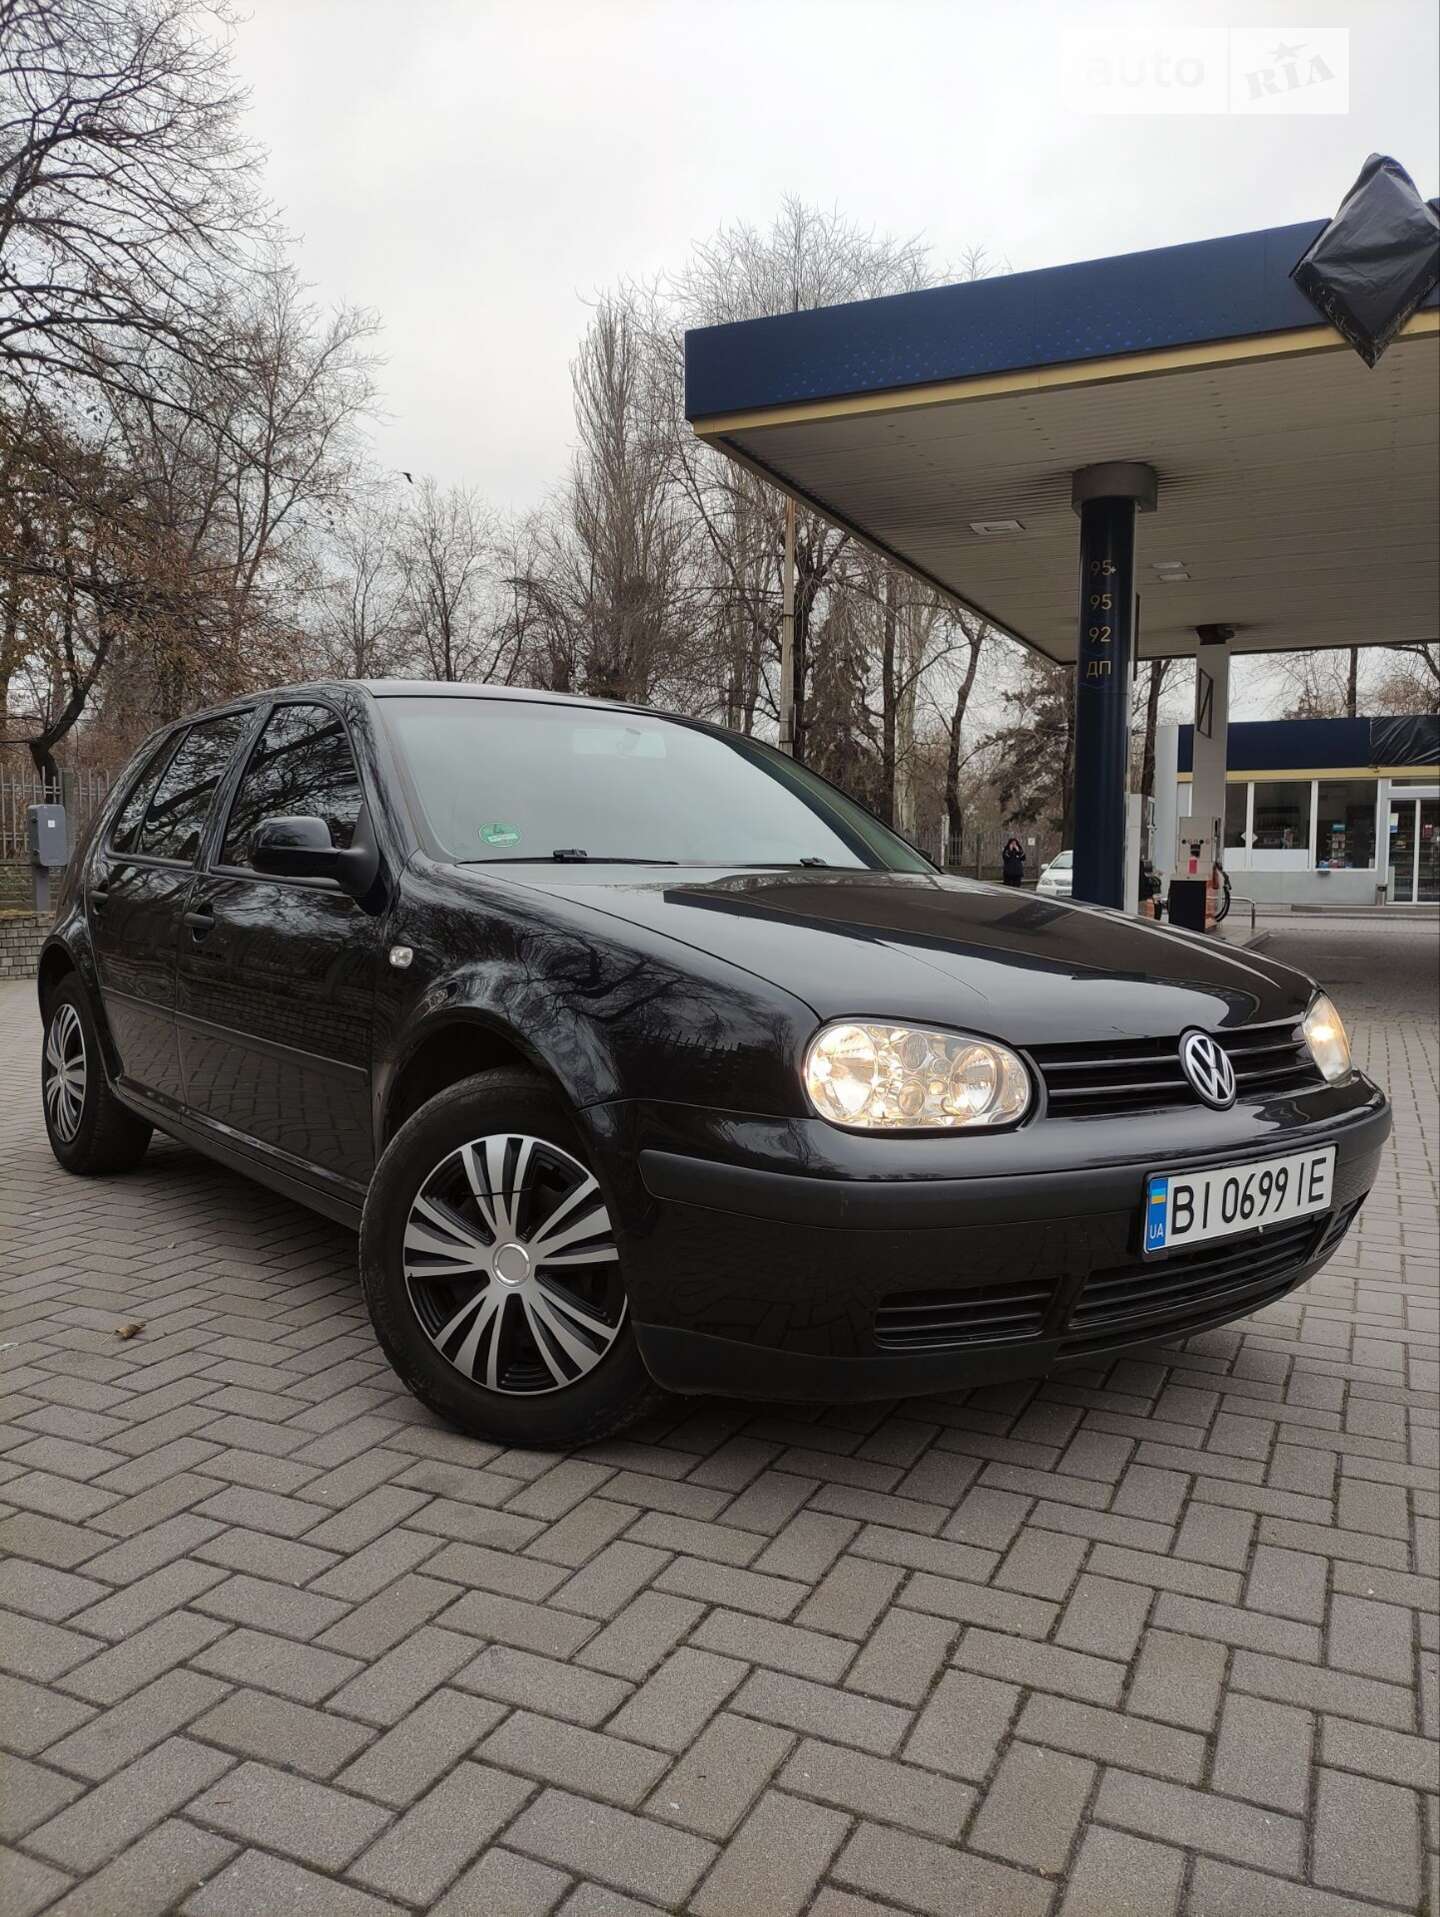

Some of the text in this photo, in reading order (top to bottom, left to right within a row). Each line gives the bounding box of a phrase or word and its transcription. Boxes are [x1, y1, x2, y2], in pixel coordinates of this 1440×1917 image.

[1089, 593, 1113, 610] 95
[1088, 626, 1112, 643] 92
[1086, 660, 1112, 679] ДП
[1171, 1157, 1327, 1235] BI 0699 IE
[1149, 1223, 1164, 1240] UA
